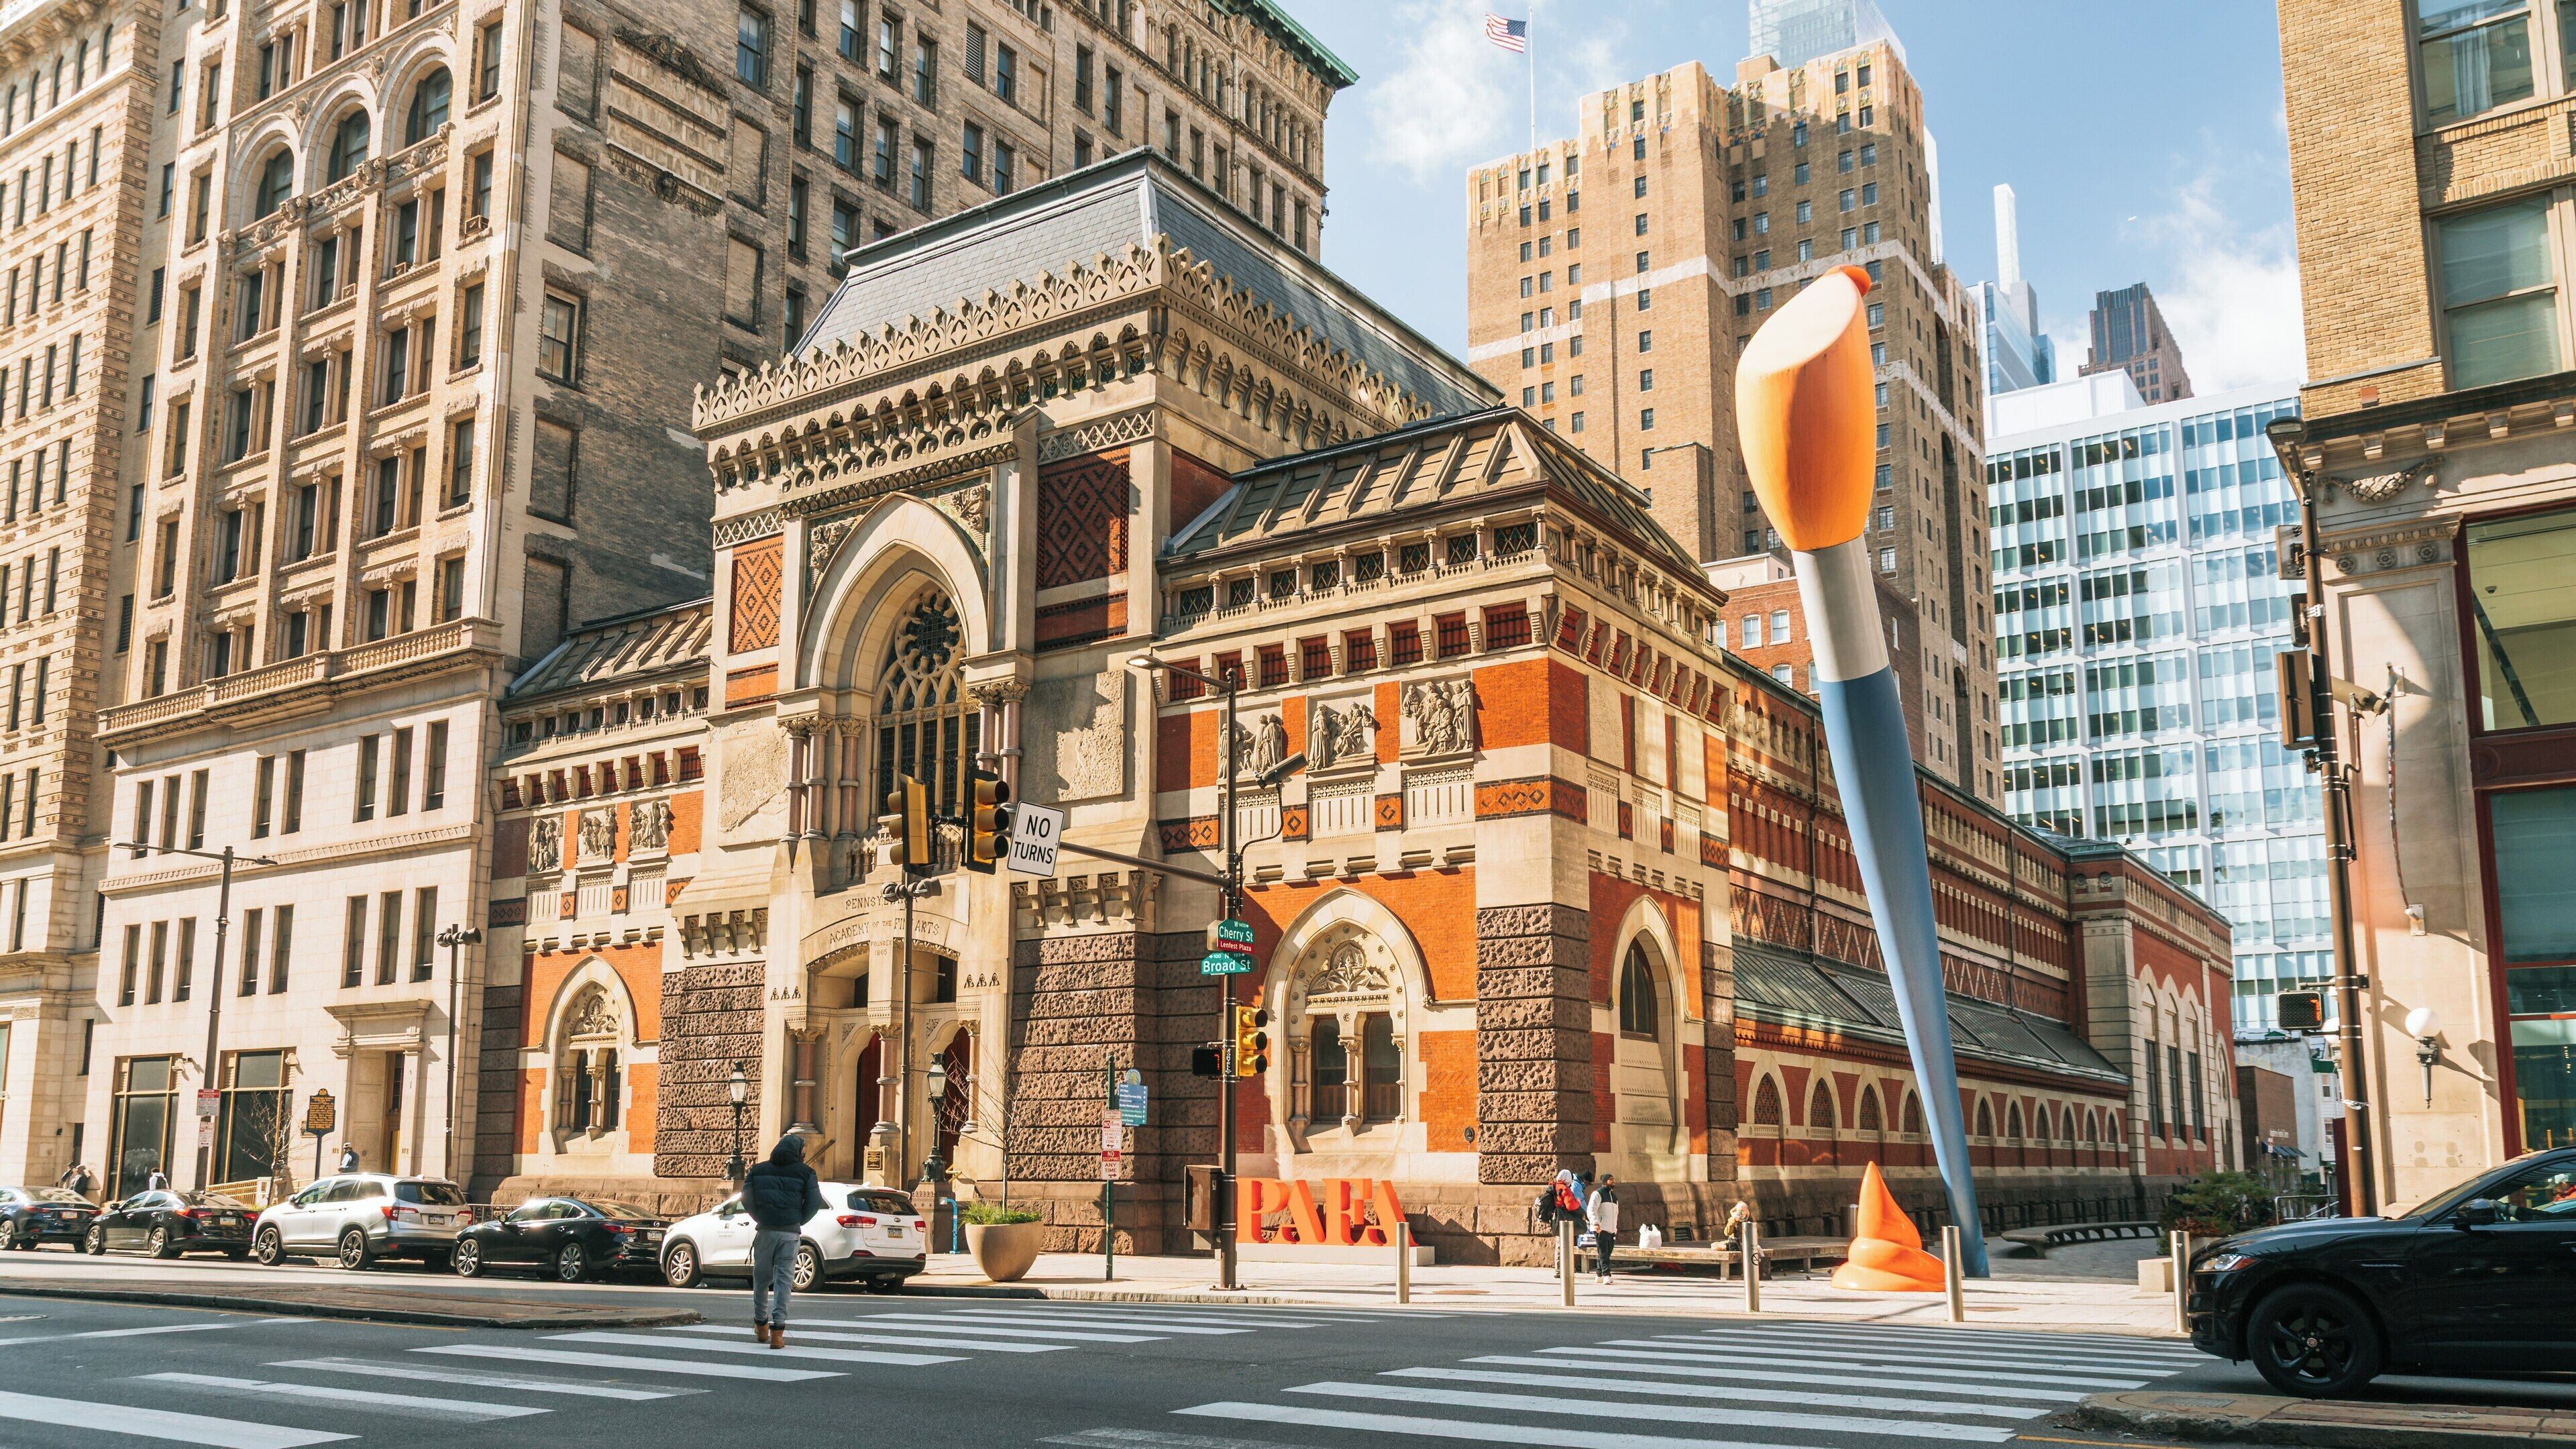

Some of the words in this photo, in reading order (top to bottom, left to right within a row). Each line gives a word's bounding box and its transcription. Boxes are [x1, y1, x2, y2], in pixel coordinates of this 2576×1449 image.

[1026, 814, 1051, 838] NO
[1014, 841, 1054, 864] TURNS
[830, 922, 869, 944] ACADEMY
[914, 920, 940, 936] ARTS
[1219, 926, 1244, 942] Cherry
[1246, 930, 1253, 942] St
[1220, 941, 1238, 950] Lenfest
[1239, 944, 1252, 952] Plaza
[1203, 960, 1236, 973] Broad
[1240, 960, 1250, 971] St
[1236, 1177, 1419, 1246] PAFA
